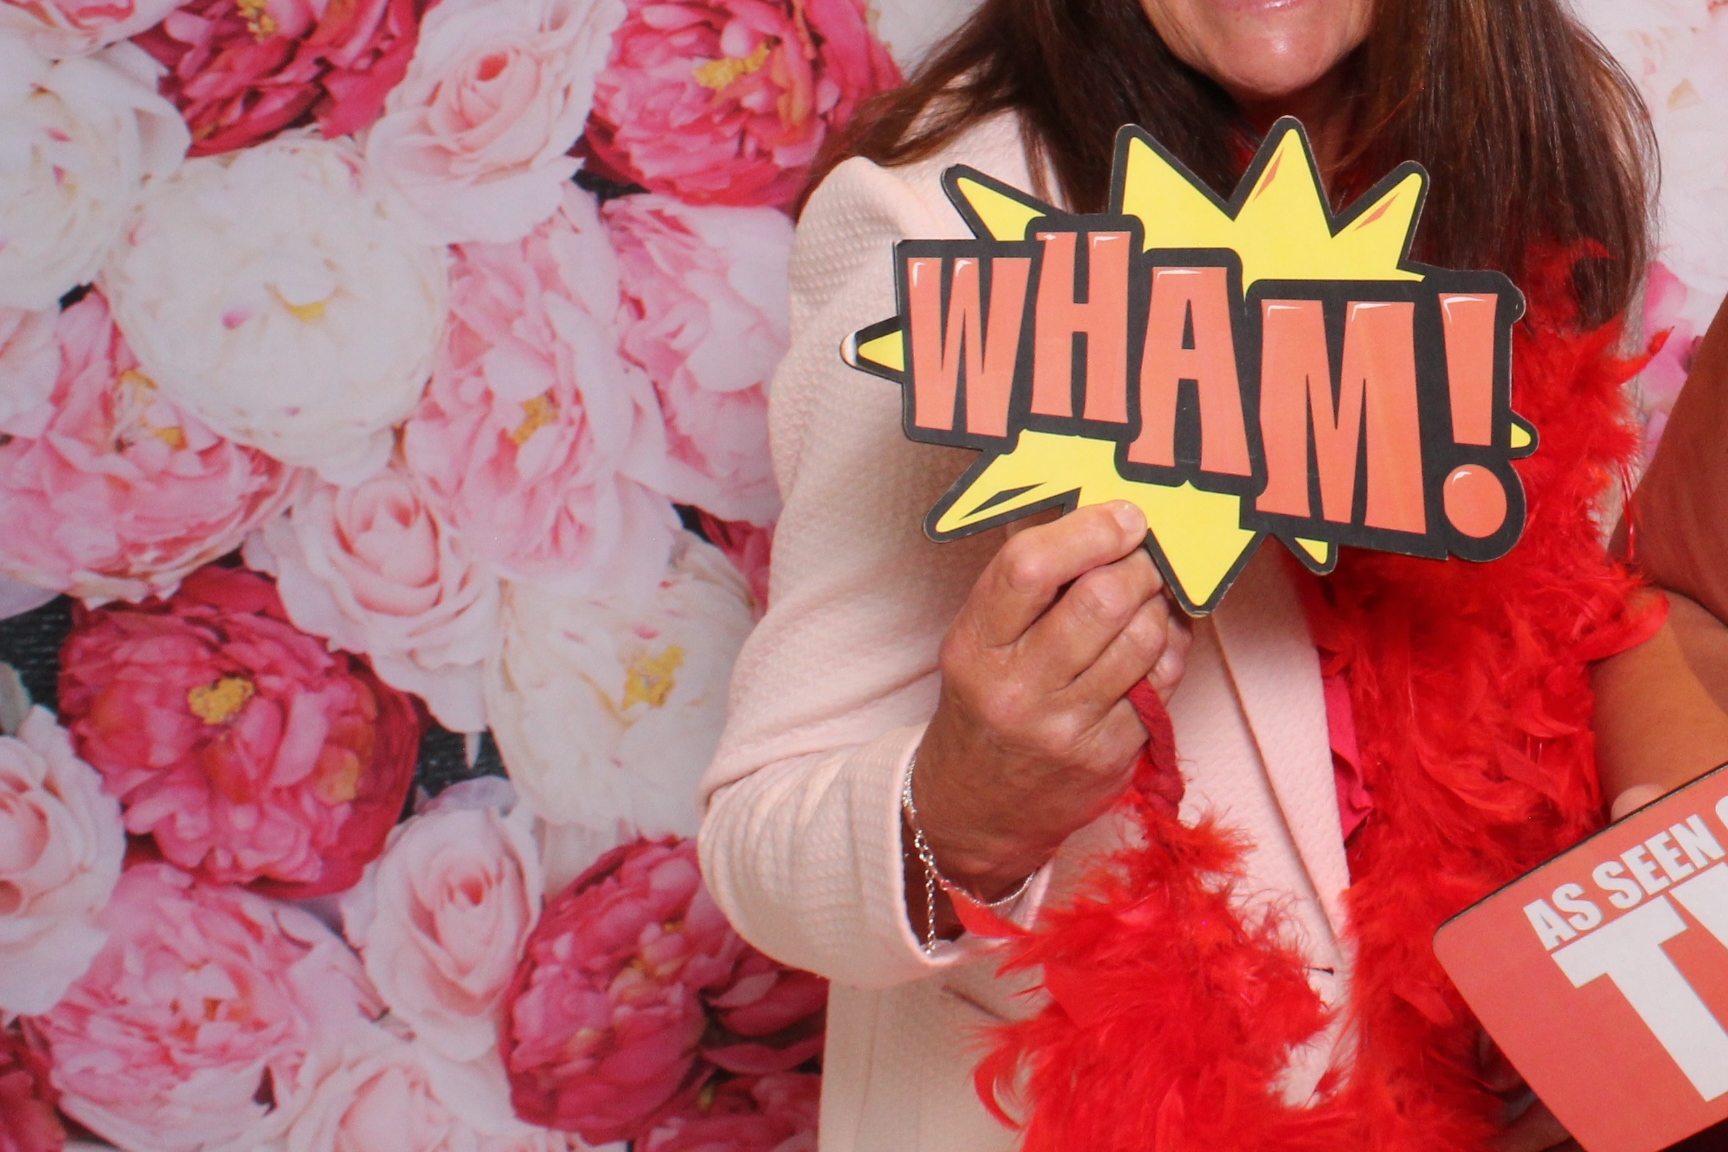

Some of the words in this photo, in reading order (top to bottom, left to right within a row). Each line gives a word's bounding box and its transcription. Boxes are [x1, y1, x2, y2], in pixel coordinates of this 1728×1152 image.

[906, 230, 1508, 539] WHAM!
[1523, 882, 1603, 951] AS
[1591, 813, 1727, 909] SEEN
